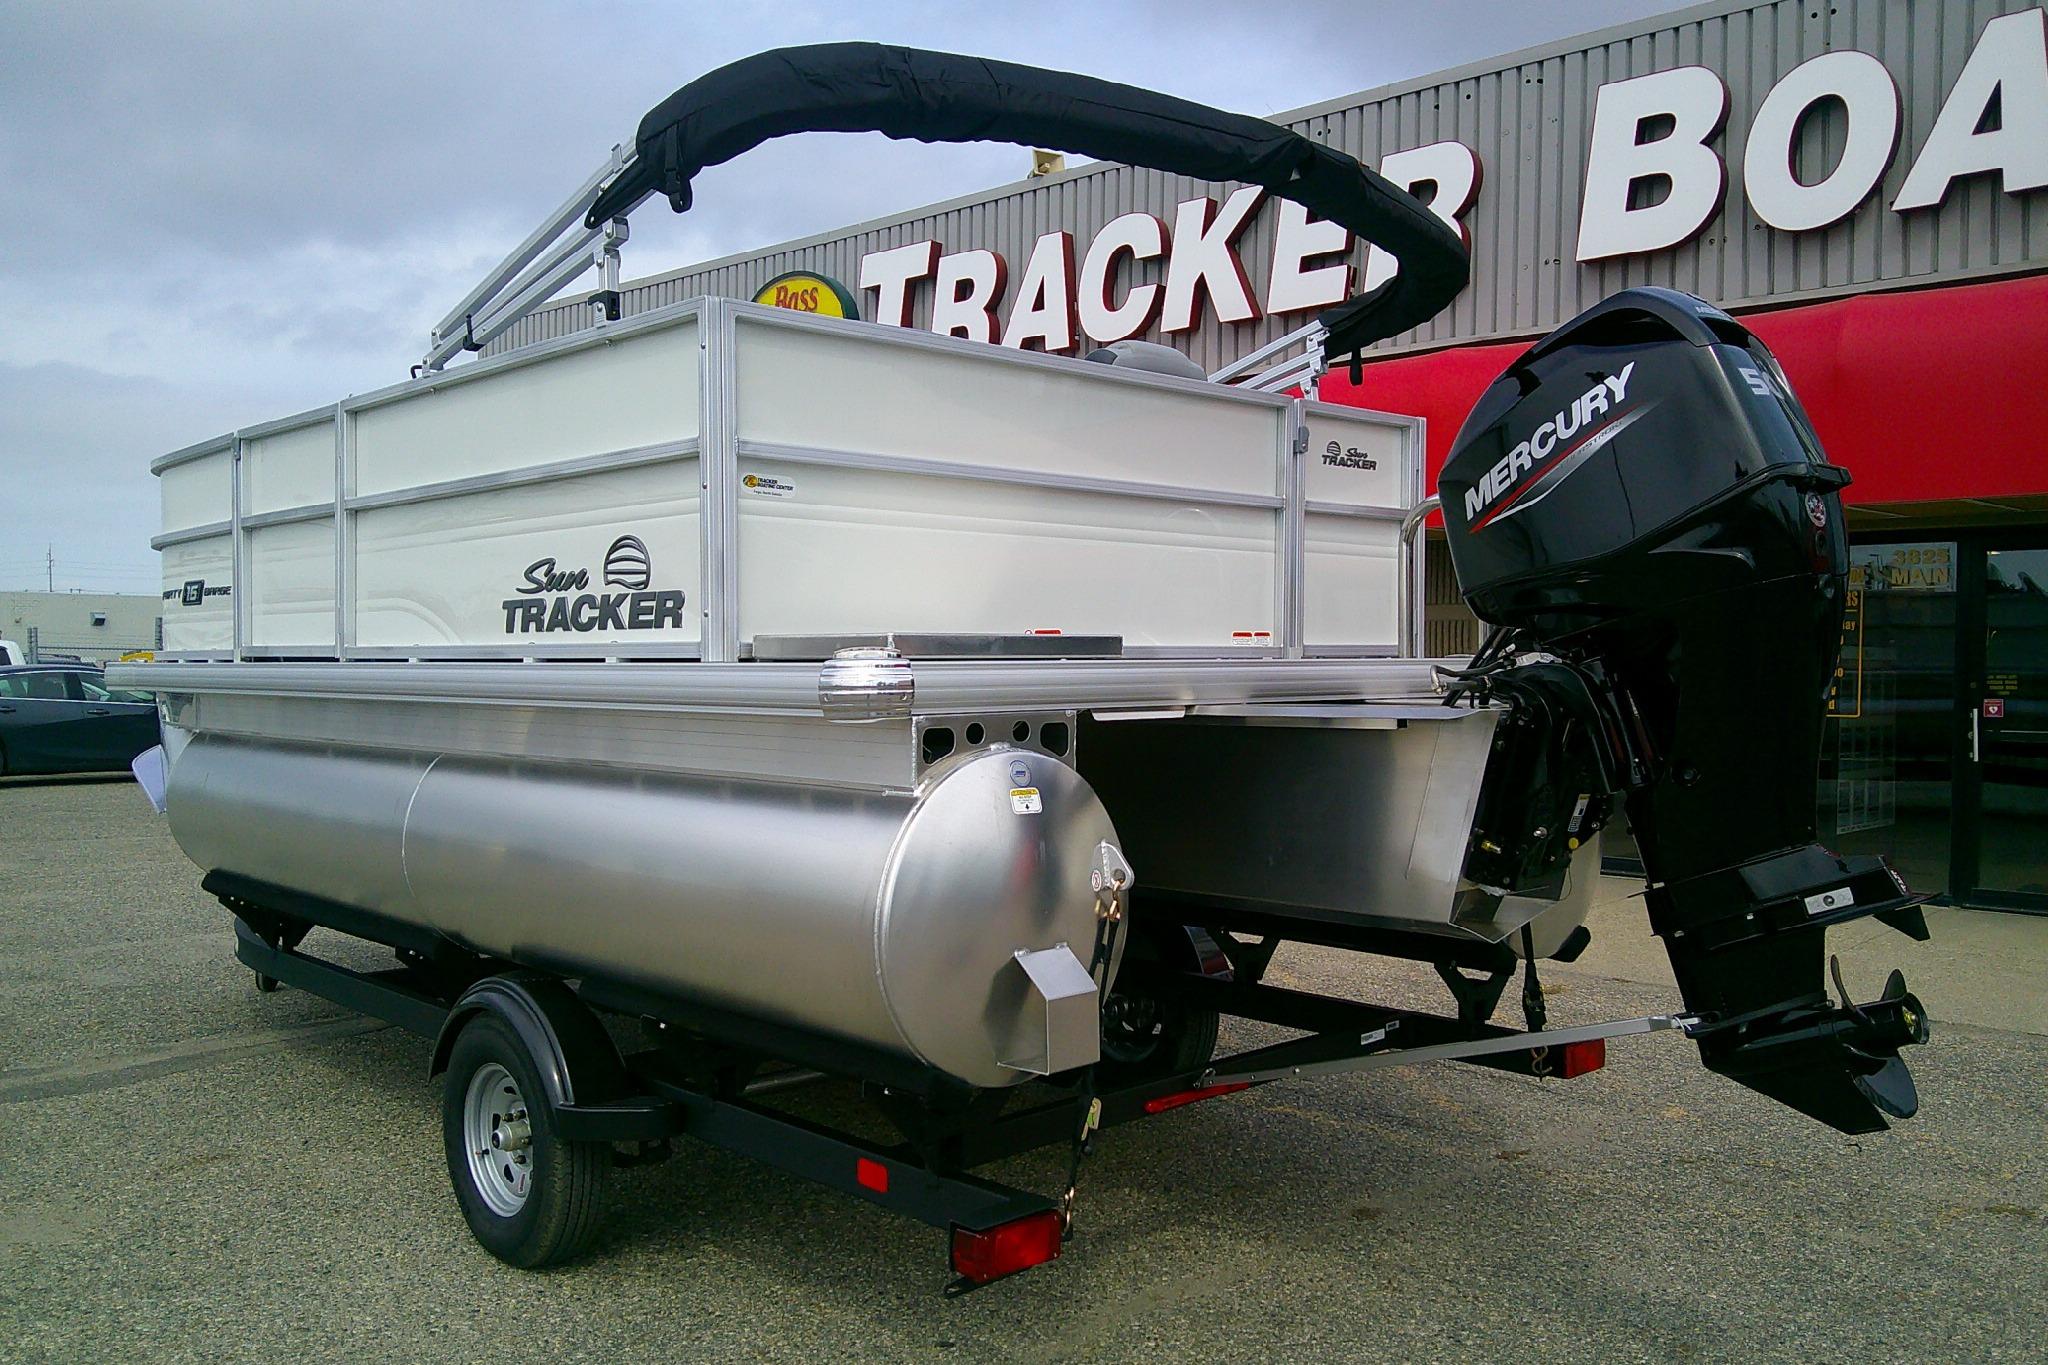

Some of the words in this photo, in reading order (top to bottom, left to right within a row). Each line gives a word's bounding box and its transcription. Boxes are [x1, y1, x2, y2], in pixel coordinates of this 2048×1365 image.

[859, 141, 1483, 352] TRACKER
[1575, 6, 2048, 263] BOA
[774, 285, 819, 312] Bass
[1464, 361, 1635, 521] MERCURY
[1321, 454, 1378, 471] TRACKER
[515, 557, 590, 595] Sun
[1891, 568, 1950, 585] MAIN
[502, 589, 686, 634] TRACKER
